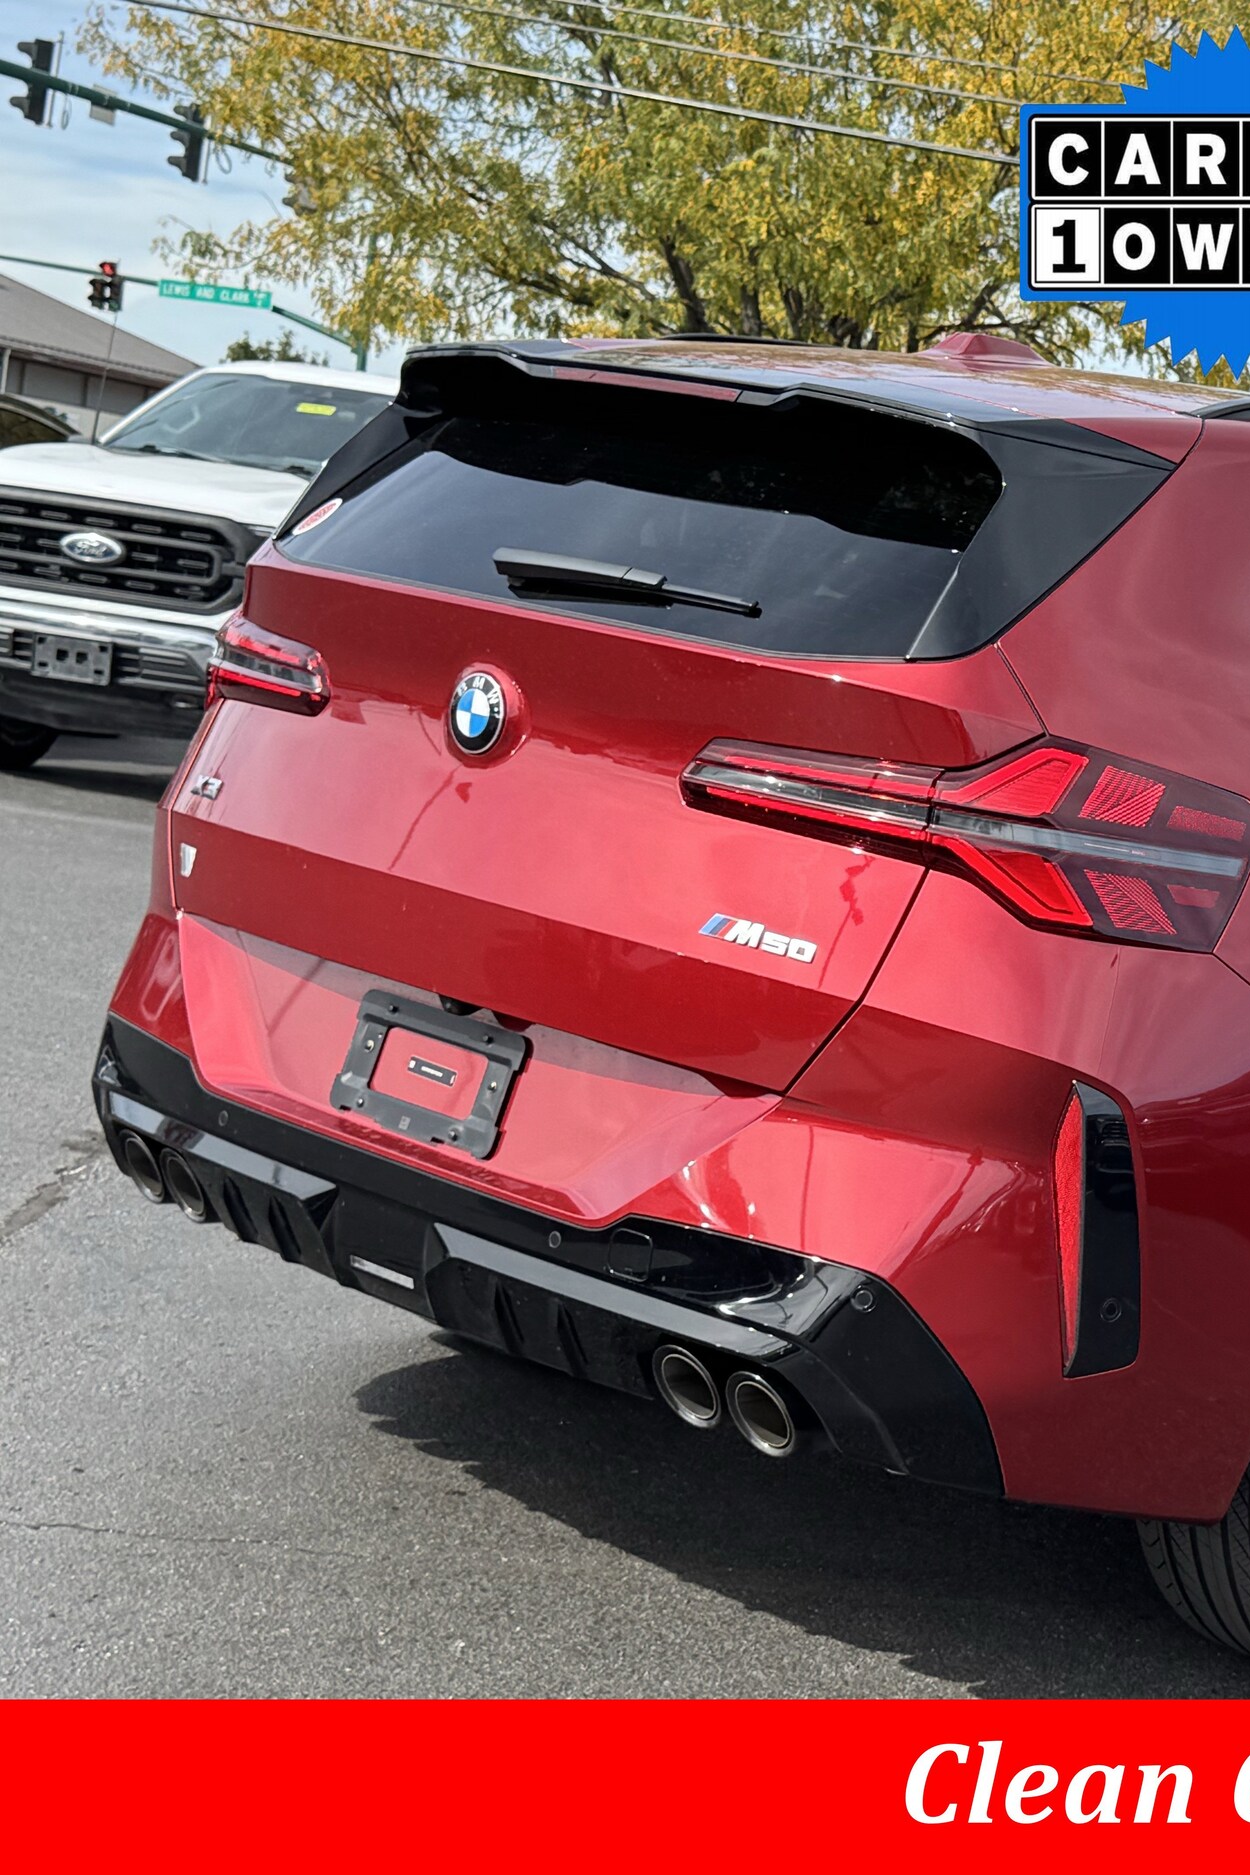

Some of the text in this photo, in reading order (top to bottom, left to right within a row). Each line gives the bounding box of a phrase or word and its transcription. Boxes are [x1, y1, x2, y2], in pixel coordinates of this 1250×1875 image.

[196, 286, 215, 299] AND
[457, 676, 500, 704] BMW
[723, 919, 818, 963] M50
